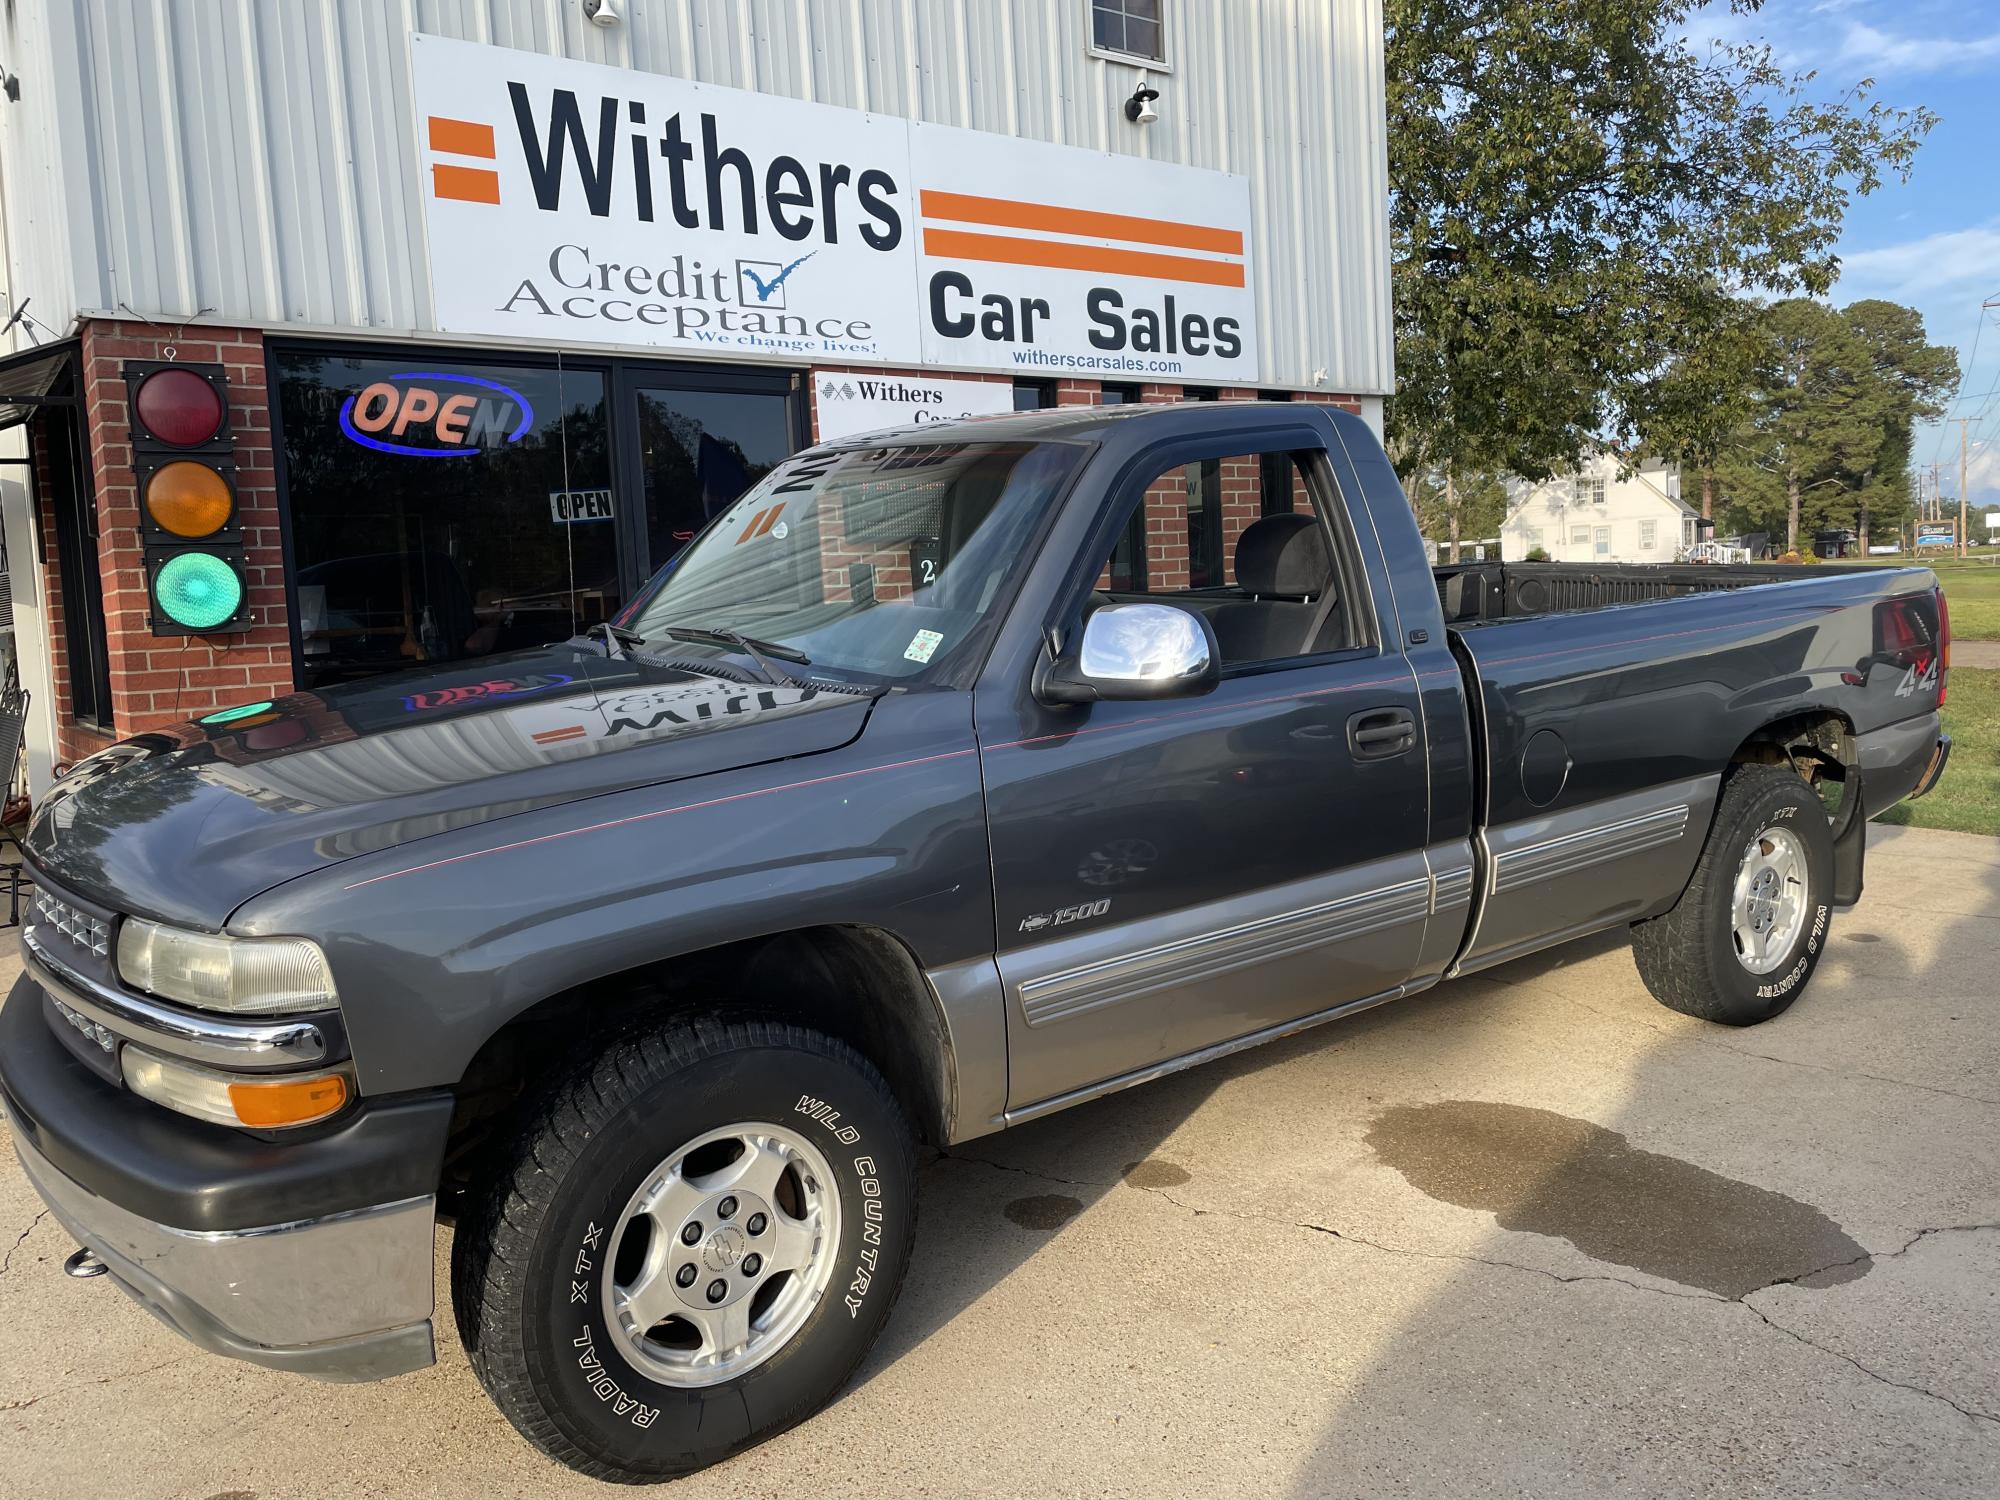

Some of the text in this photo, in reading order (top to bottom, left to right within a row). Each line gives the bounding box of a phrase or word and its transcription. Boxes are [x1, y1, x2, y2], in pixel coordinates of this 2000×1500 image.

[507, 81, 901, 252] Withers
[549, 244, 731, 302] Credit
[495, 279, 872, 339] Acceptance
[929, 270, 1242, 358] Car Sales
[694, 330, 877, 353] We change lives!
[1012, 348, 1182, 373] witherscarsales.com
[353, 382, 514, 449] OPEN
[857, 380, 943, 403] Withers
[556, 491, 612, 520] OPEN
[1053, 898, 1111, 926] 1500
[1757, 905, 1828, 998] WILD COUNTRY
[794, 1094, 884, 1319] WILD COUNTRY
[571, 1222, 661, 1429] RADIAL XTX
